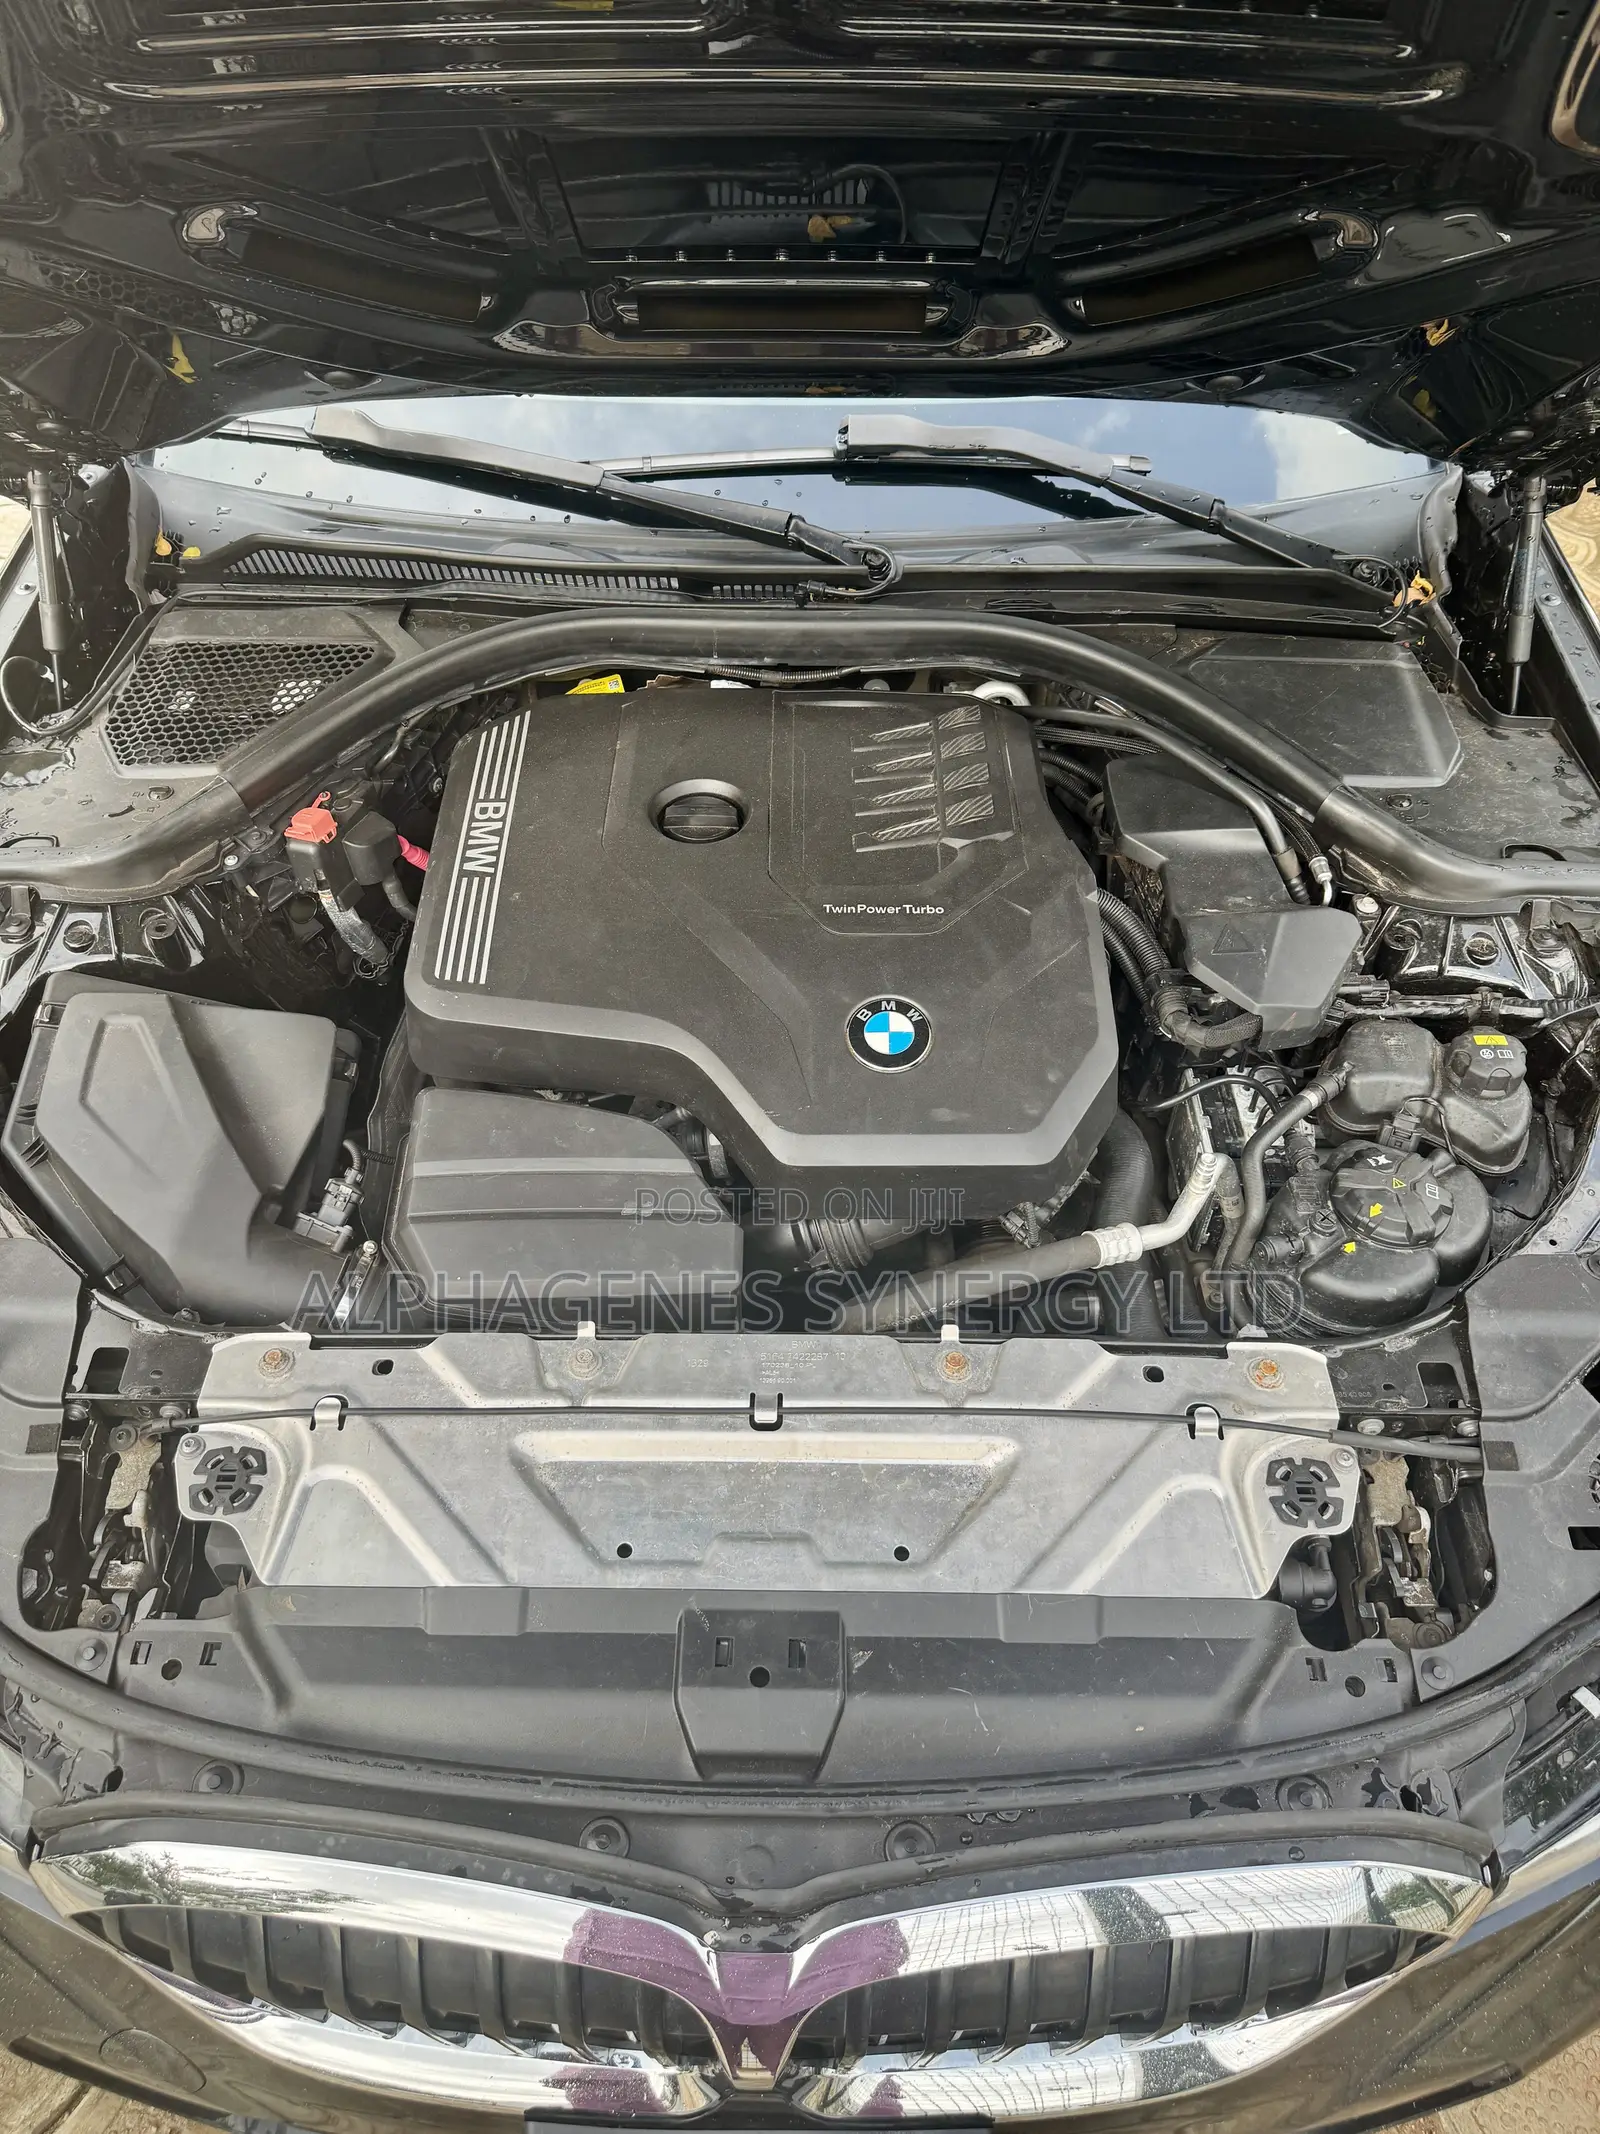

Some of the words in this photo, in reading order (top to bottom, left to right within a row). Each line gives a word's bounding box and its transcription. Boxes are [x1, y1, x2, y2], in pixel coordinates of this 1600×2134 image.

[462, 801, 507, 874] BMW
[902, 904, 945, 914] Turbo
[856, 1000, 923, 1022] BMW
